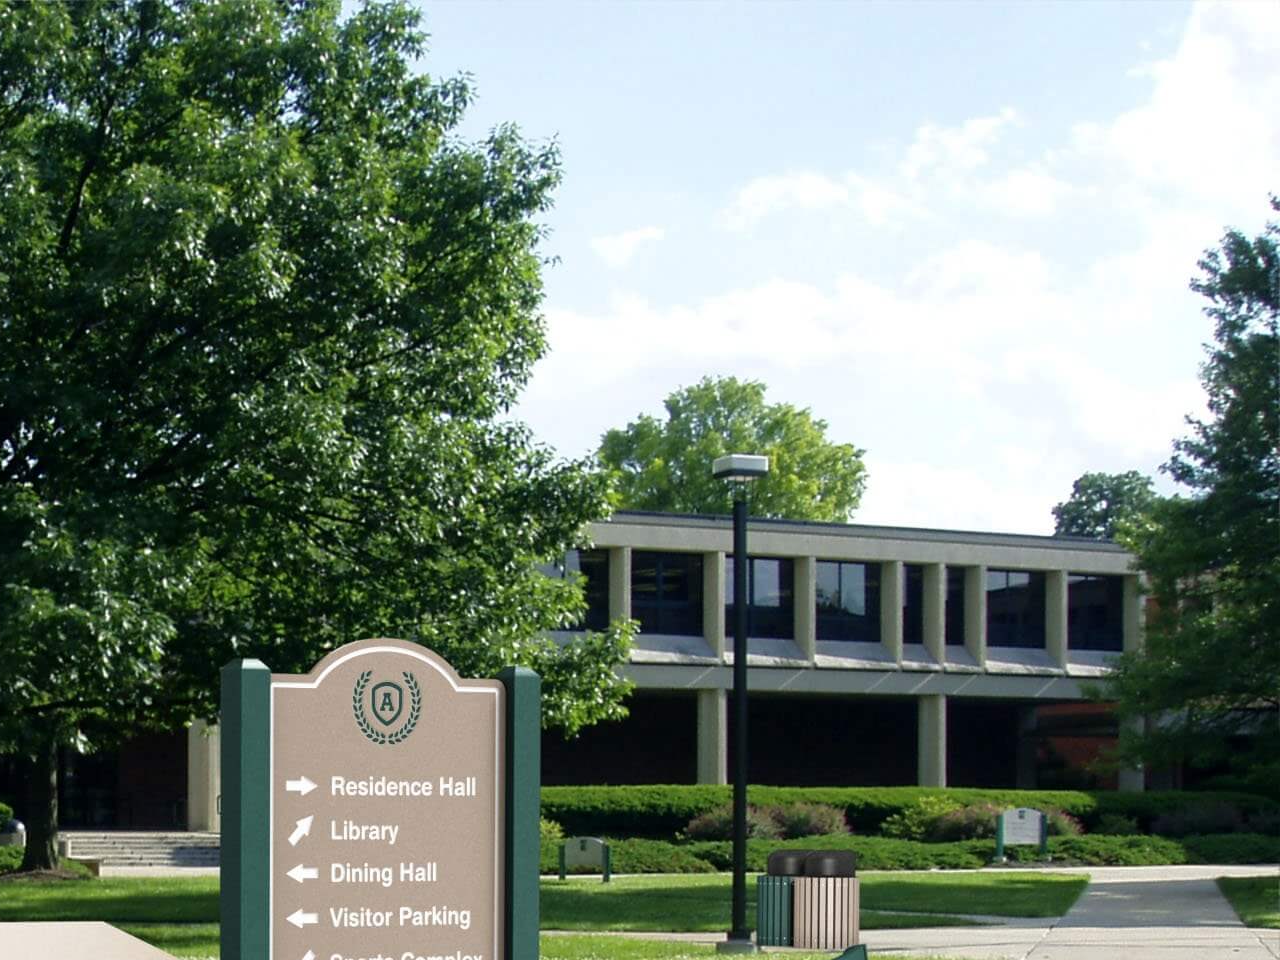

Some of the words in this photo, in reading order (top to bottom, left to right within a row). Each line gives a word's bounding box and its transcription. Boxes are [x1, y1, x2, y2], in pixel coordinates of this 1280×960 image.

[379, 692, 395, 712] A
[331, 775, 433, 797] Residence
[439, 776, 476, 797] Hall
[331, 820, 399, 845] Library
[330, 862, 393, 887] Dining
[399, 861, 437, 882] Hall
[329, 906, 394, 928] Visitor
[399, 905, 471, 930] Parking
